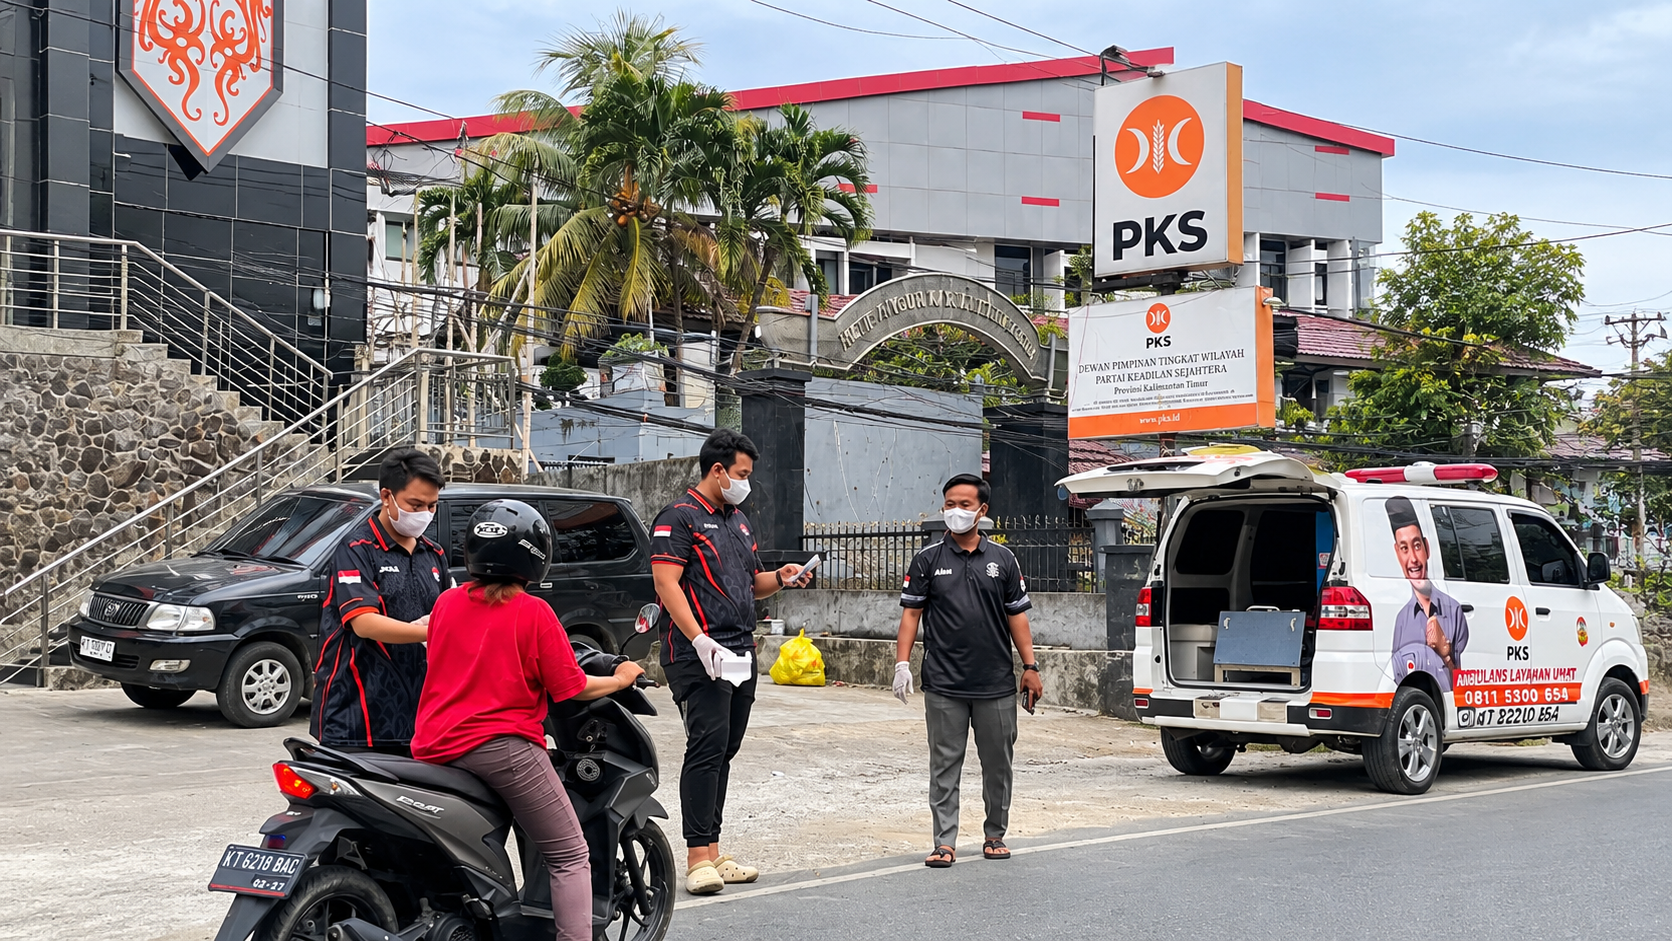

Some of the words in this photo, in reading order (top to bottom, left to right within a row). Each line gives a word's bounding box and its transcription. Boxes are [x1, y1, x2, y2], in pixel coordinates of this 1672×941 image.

[1112, 209, 1208, 261] PKS
[1146, 335, 1172, 349] PKS
[1078, 362, 1110, 374] DEWAN
[1112, 357, 1157, 371] PIMPINAN
[1158, 354, 1200, 367] TINGKAT
[1200, 349, 1245, 361] WILAYAH
[1095, 373, 1125, 385] PARTAI
[1127, 369, 1173, 382] KEADILAN
[1174, 364, 1228, 379] SEJAHTERA
[1186, 379, 1208, 389] Timur
[1507, 646, 1529, 661] PKS
[1464, 690, 1498, 705] 0811
[1505, 689, 1538, 703] 5300
[222, 850, 244, 868] KT
[241, 852, 273, 871] 6218
[272, 857, 300, 875] BAC
